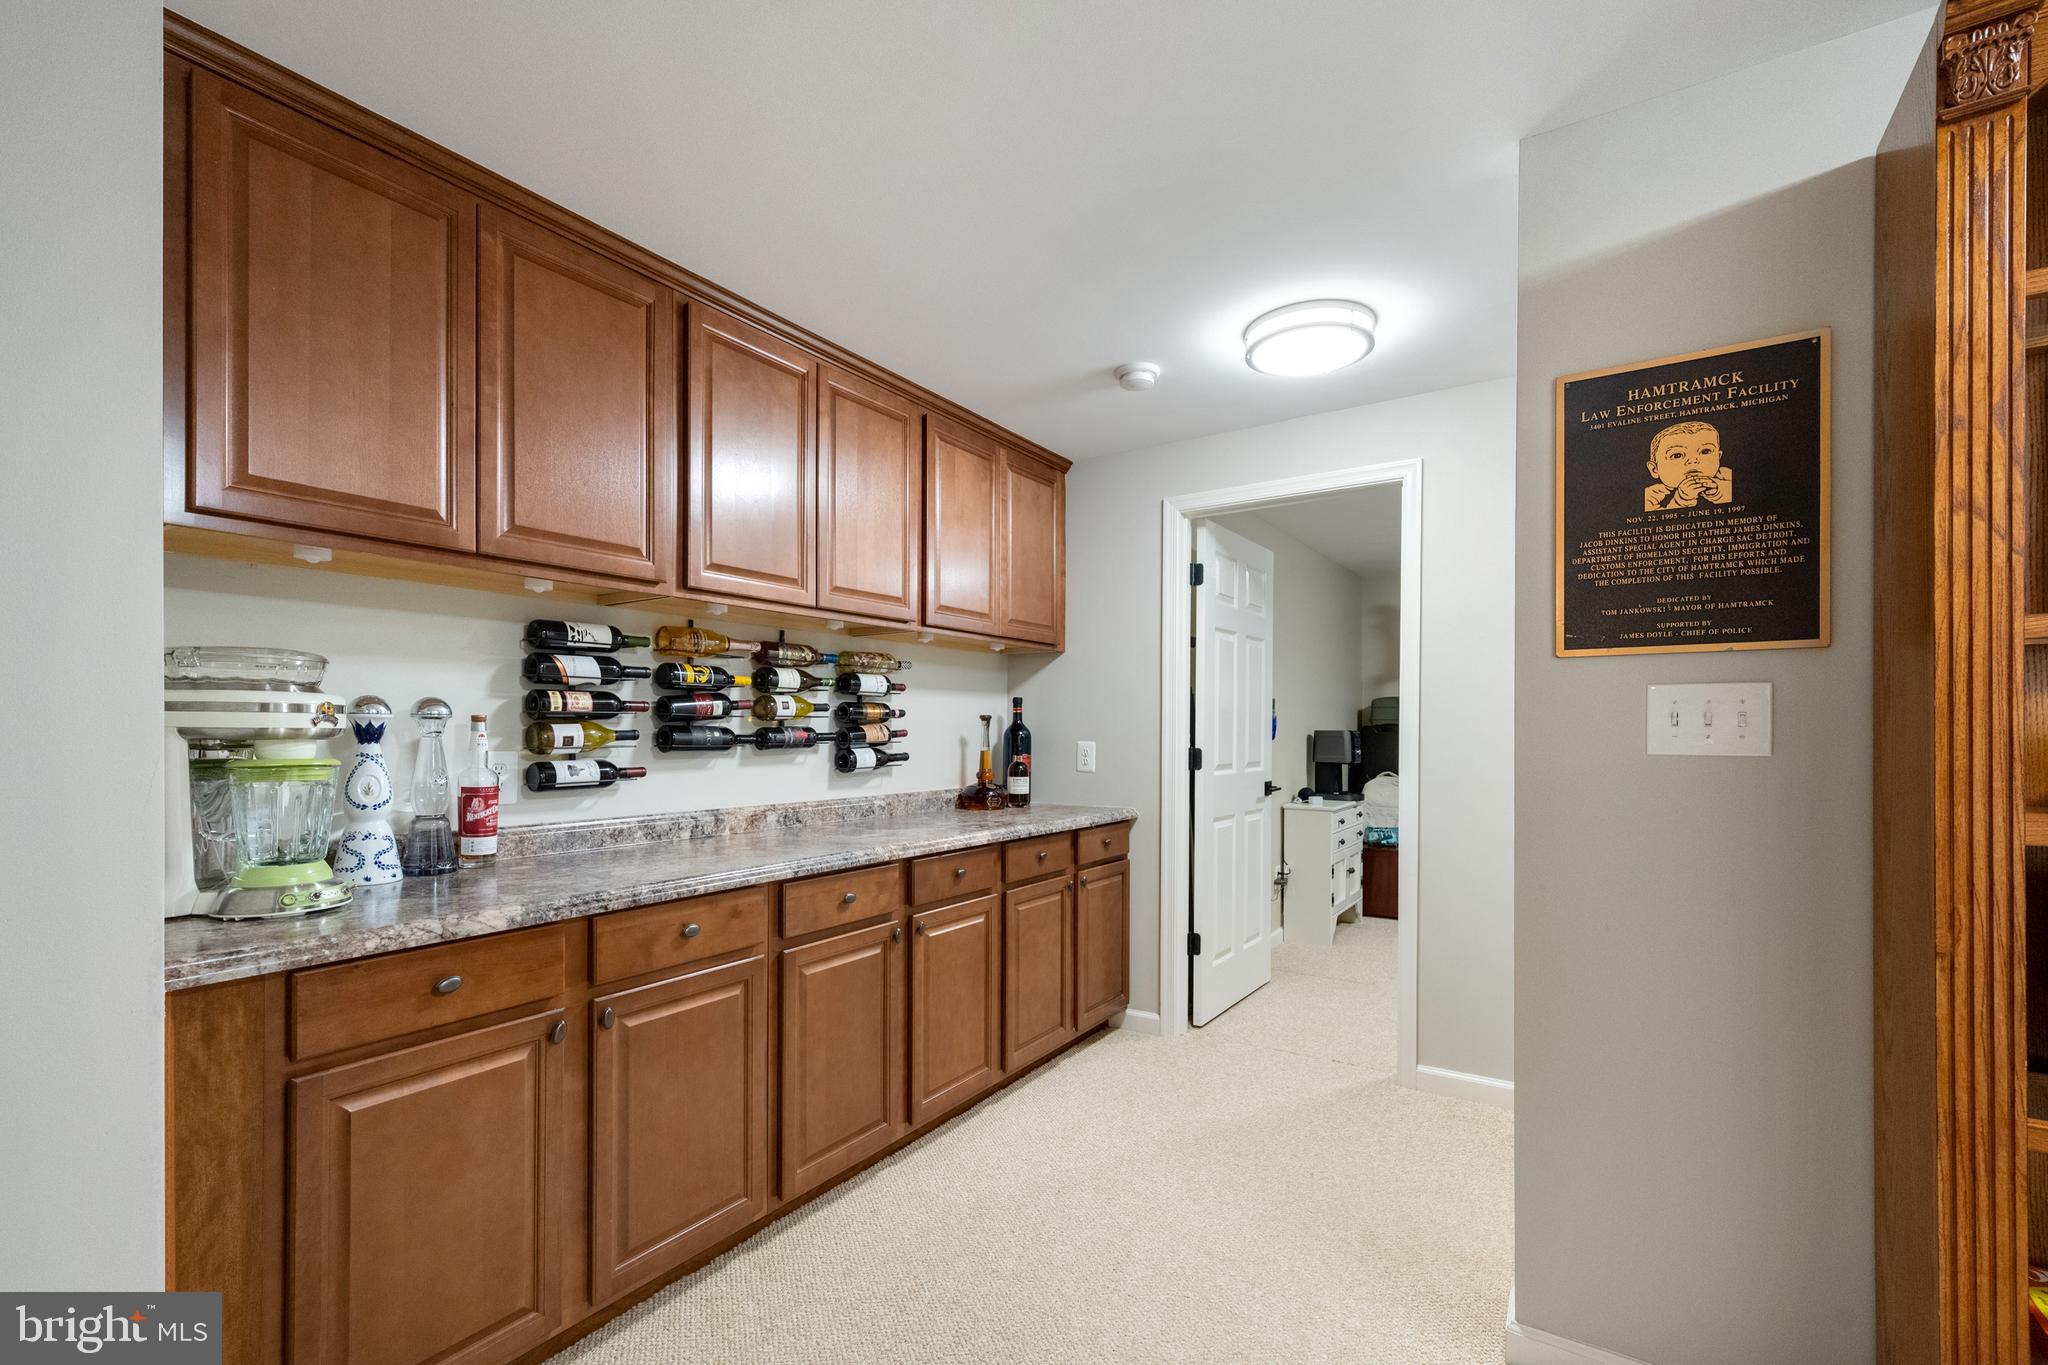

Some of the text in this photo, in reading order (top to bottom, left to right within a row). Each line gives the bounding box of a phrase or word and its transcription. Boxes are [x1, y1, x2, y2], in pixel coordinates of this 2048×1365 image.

[1627, 370, 1744, 402] HAMTRAMCK
[1590, 422, 1605, 431] 3401
[1607, 417, 1642, 428] EVALINE
[1644, 412, 1677, 422] STREET,
[1741, 394, 1789, 408] MICHIGAN
[1626, 516, 1645, 524] NOV.
[1687, 509, 1710, 518] JUNE
[1728, 505, 1746, 513] 1997
[1579, 540, 1604, 549] JACOB
[1605, 536, 1638, 546] DINKINS
[1640, 534, 1650, 543] TO
[1652, 532, 1680, 542] HONOR
[1682, 530, 1696, 539] HIS
[1698, 526, 1731, 538] FATHER
[1733, 524, 1763, 534] JAMES
[1599, 530, 1616, 539] THIS
[1618, 526, 1654, 537] FACILITY
[1665, 520, 1713, 532] DEDICATED
[1727, 516, 1764, 526] MEMORY
[1766, 514, 1778, 522] OF
[1572, 554, 1622, 565] DEPARTMENT
[1623, 552, 1634, 560] OF
[1636, 549, 1680, 560] HOMELAND
[1728, 539, 1788, 552] IMMIGRATION
[1790, 537, 1811, 546] AND
[1582, 546, 1622, 556] ASSISTANT
[1624, 542, 1657, 552] SPECIAL
[1658, 540, 1686, 550] AGENT
[1700, 536, 1734, 546] CHARGE
[1736, 533, 1754, 542] SAC
[1578, 554, 1806, 580] DEDICATION TO THE CITY OF HAMTRAMCK WHICH MADE
[1590, 562, 1626, 572] CUSTOMS
[1693, 554, 1710, 562] FOR
[1711, 553, 1726, 561] HIS
[1728, 550, 1766, 560] EFFORTS
[1768, 548, 1787, 556] AND
[1594, 566, 1783, 587] THE COMPLETION OF THIS FACILITY POSSIBLE.
[1619, 606, 1666, 616] JANKOWSKI
[1673, 604, 1702, 612] MAYOR
[1704, 602, 1716, 610] OF
[1718, 599, 1774, 609] HAMTRAMCK
[1656, 595, 1700, 604] DEDICATED
[1646, 630, 1674, 638] DOYLE
[1680, 629, 1707, 637] CHIEF
[1722, 626, 1753, 634] POLICE
[1656, 620, 1700, 629] SUPPORTED
